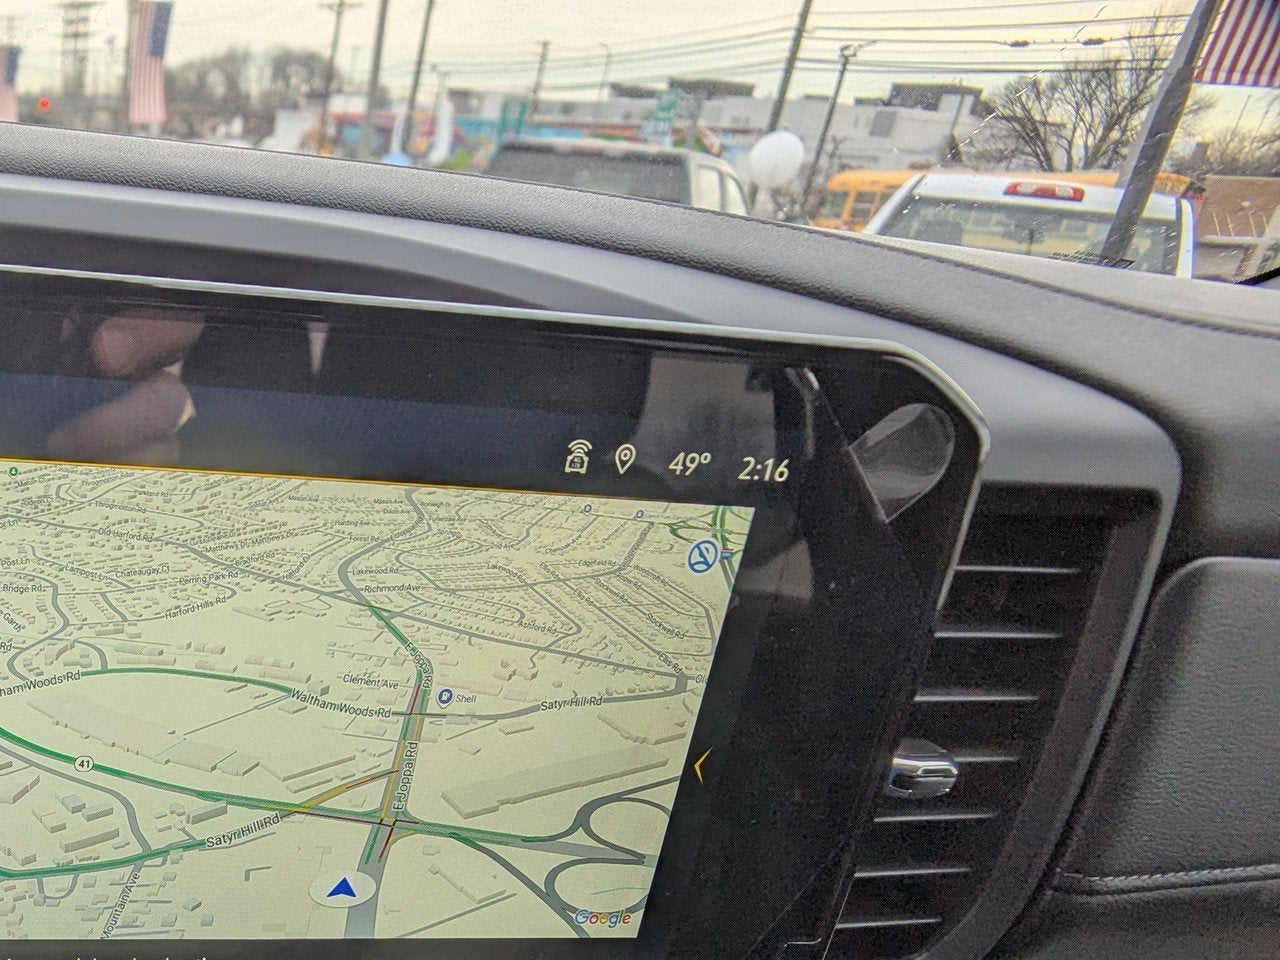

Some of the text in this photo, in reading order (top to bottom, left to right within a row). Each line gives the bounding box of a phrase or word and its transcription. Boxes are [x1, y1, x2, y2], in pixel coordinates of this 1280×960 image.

[737, 456, 790, 483] 2:16
[160, 490, 169, 498] Rd
[95, 500, 147, 514] Throgmorton Rd
[7, 518, 18, 527] Ln
[97, 527, 153, 542] Old Harford Rd
[251, 534, 286, 547] Matthews
[349, 534, 380, 543] Forest Rd
[205, 541, 238, 554] Matthews
[1, 559, 19, 569] Post
[20, 555, 31, 565] Ln
[235, 551, 276, 567] Bradford Rd
[606, 559, 616, 567] Rd
[64, 563, 109, 582] Lampost Ln
[115, 563, 171, 579] Chateaugay Ct
[208, 572, 225, 582] Park
[227, 570, 239, 579] Rd
[352, 566, 399, 575] Lakewood Rd
[487, 562, 518, 579] Lakewood
[2, 583, 30, 595] Bridge
[30, 584, 43, 593] Rd
[364, 583, 421, 593] Richmond Ave
[165, 595, 228, 620] Harford Hills Rd
[3, 612, 23, 634] Garth
[645, 612, 675, 637] Stockwell
[0, 641, 14, 652] Rd
[658, 652, 672, 667] Ellis
[410, 649, 430, 675] Joppa
[422, 673, 434, 689] Rd
[25, 674, 64, 691] Woods
[65, 670, 81, 682] Rd
[342, 673, 399, 690] Clement Ave
[292, 687, 392, 719] Waltham Woods Rd
[455, 694, 477, 704] Shell
[540, 696, 603, 711] Satyr Hill Rd
[78, 759, 91, 769] 41
[392, 741, 419, 811] E Joppa Rd
[206, 812, 280, 848] Satyr Hill Rd
[100, 872, 140, 940] Mountain Ave
[575, 908, 632, 928] Google
